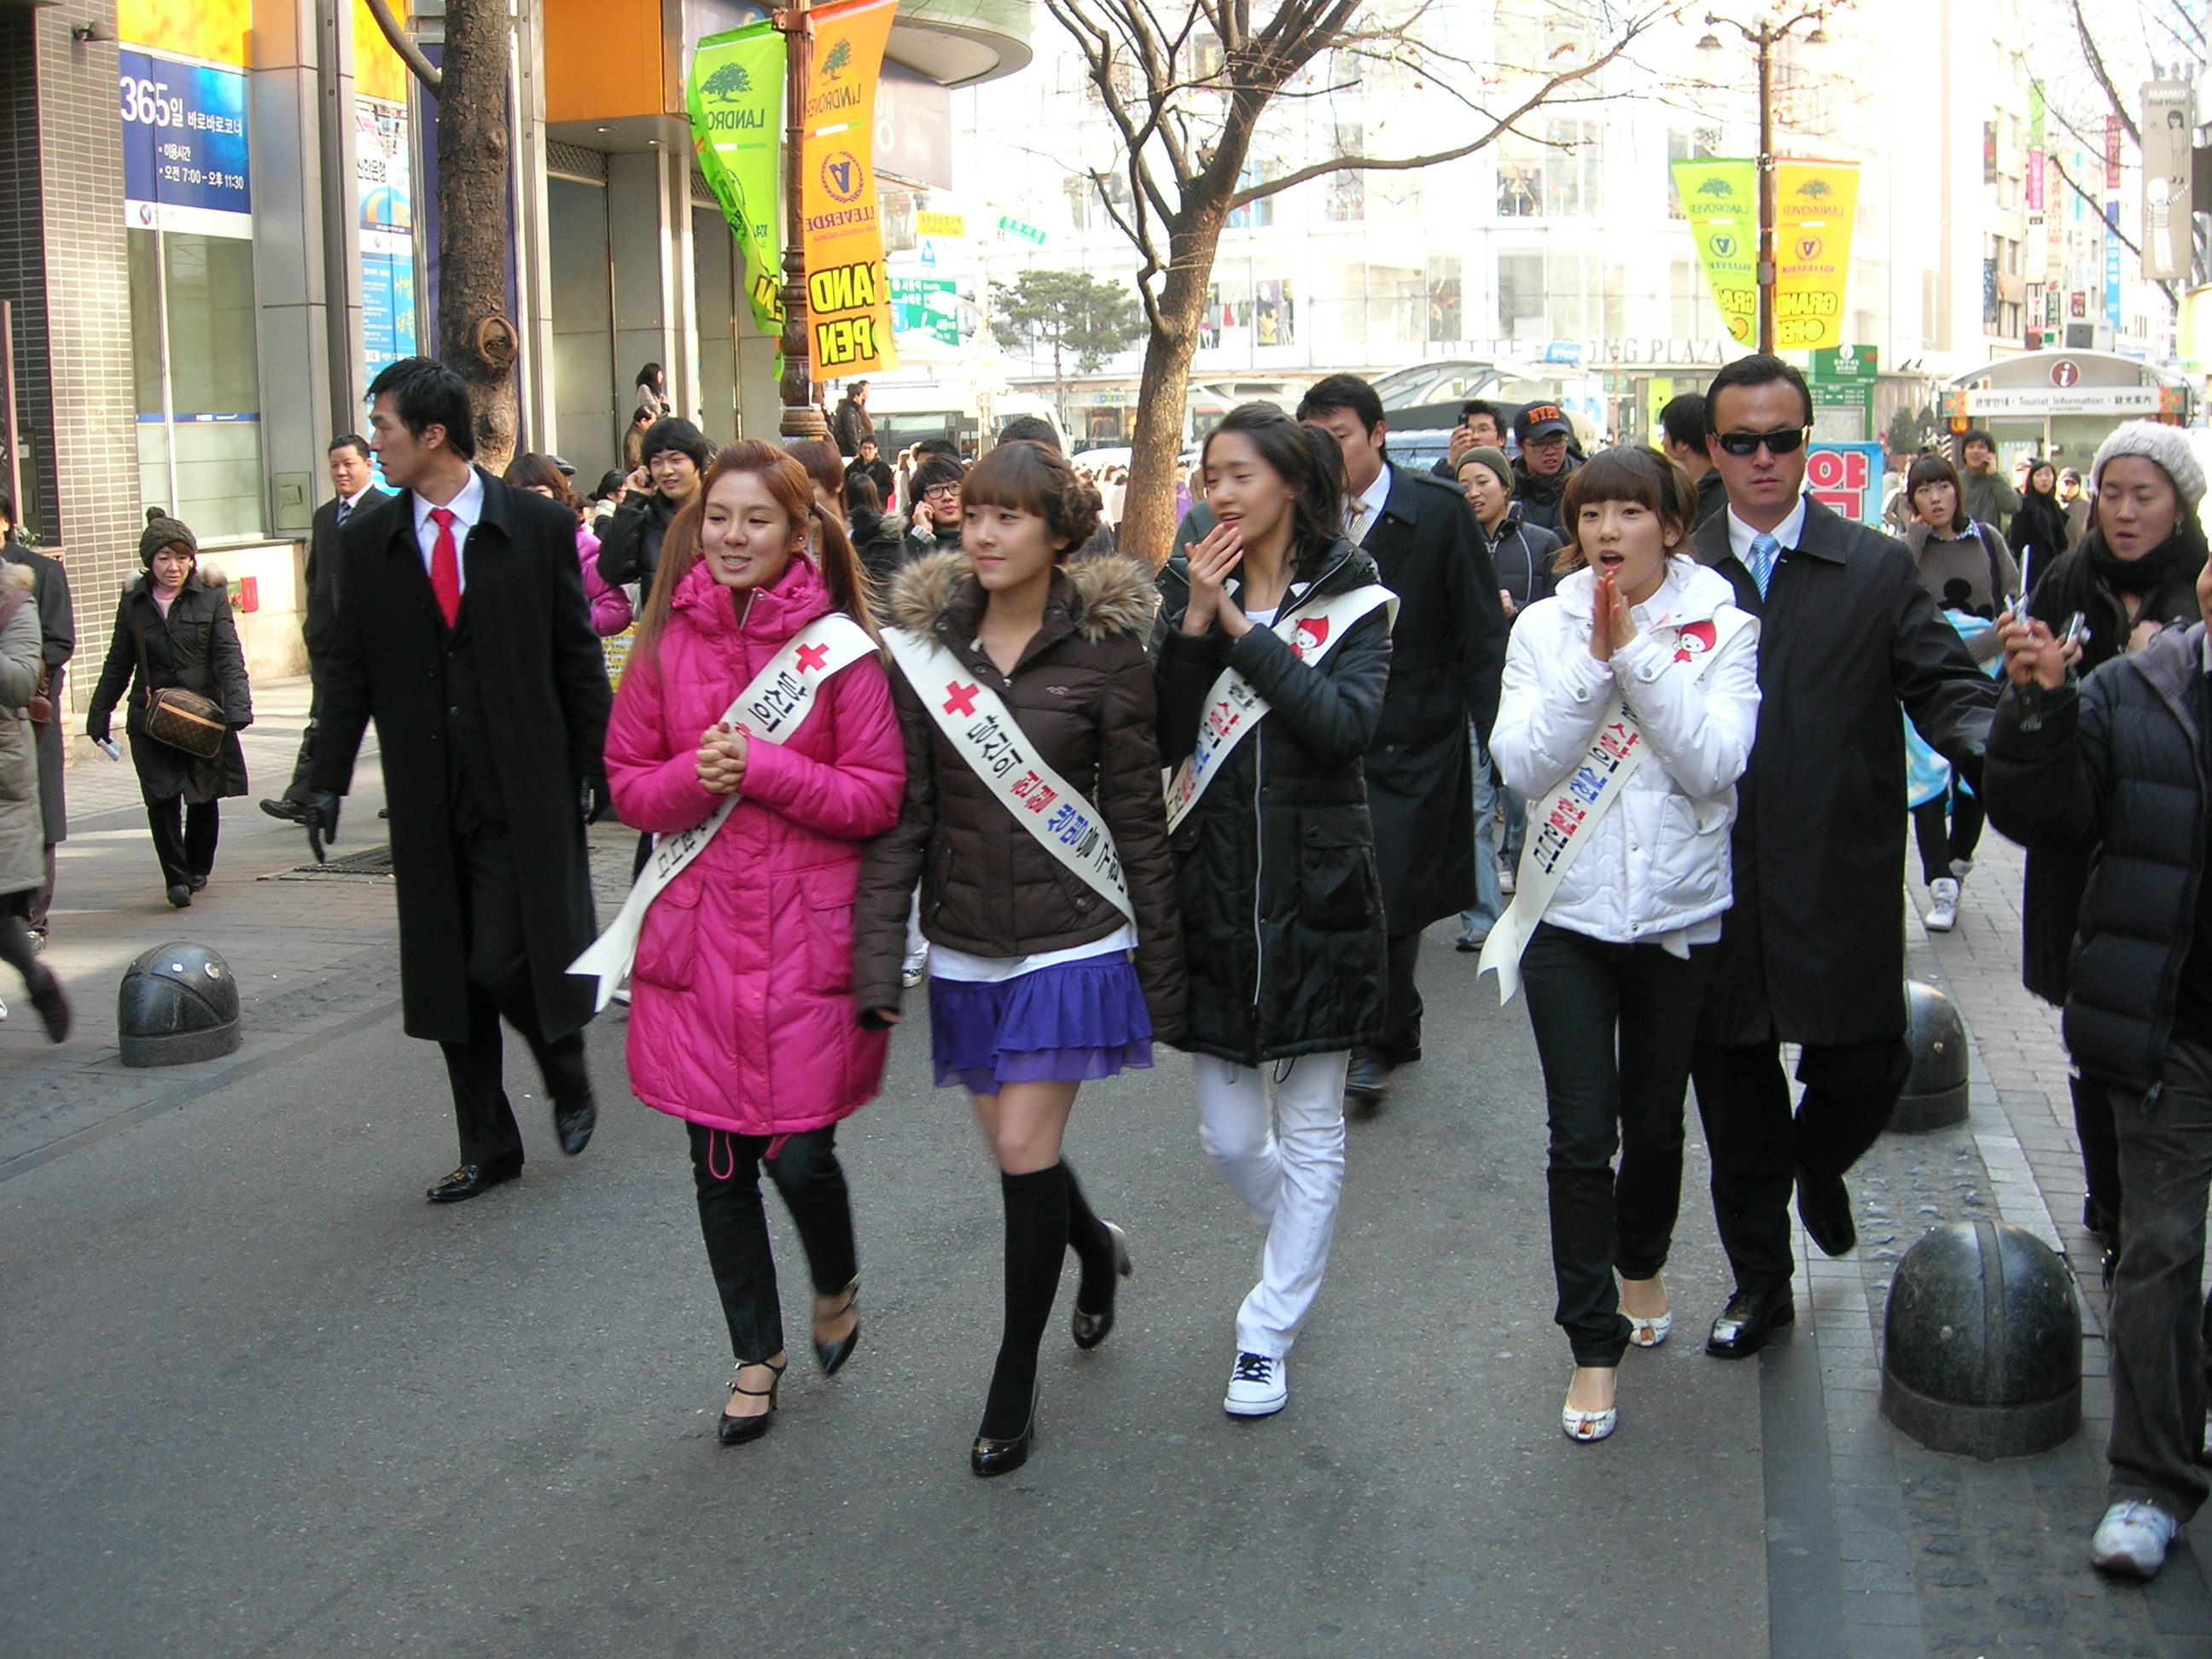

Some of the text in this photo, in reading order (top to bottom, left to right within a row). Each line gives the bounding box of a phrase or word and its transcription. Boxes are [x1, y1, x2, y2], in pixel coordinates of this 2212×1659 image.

[119, 76, 242, 137] 365일 바로바로코너
[164, 143, 191, 162] 이용시간
[165, 166, 180, 182] 오전
[183, 167, 201, 183] 7:00
[209, 171, 223, 187] 오후
[225, 175, 244, 189] 11:30
[1650, 338, 1724, 364] PLAZA
[2019, 396, 2048, 406] Tourist
[2052, 396, 2104, 405] Information
[748, 671, 807, 733] 당신의
[1587, 722, 1640, 774] 사랑의
[966, 713, 1023, 779] 당신의
[1010, 770, 1059, 814] 헌혈
[1046, 803, 1101, 859] 생명을
